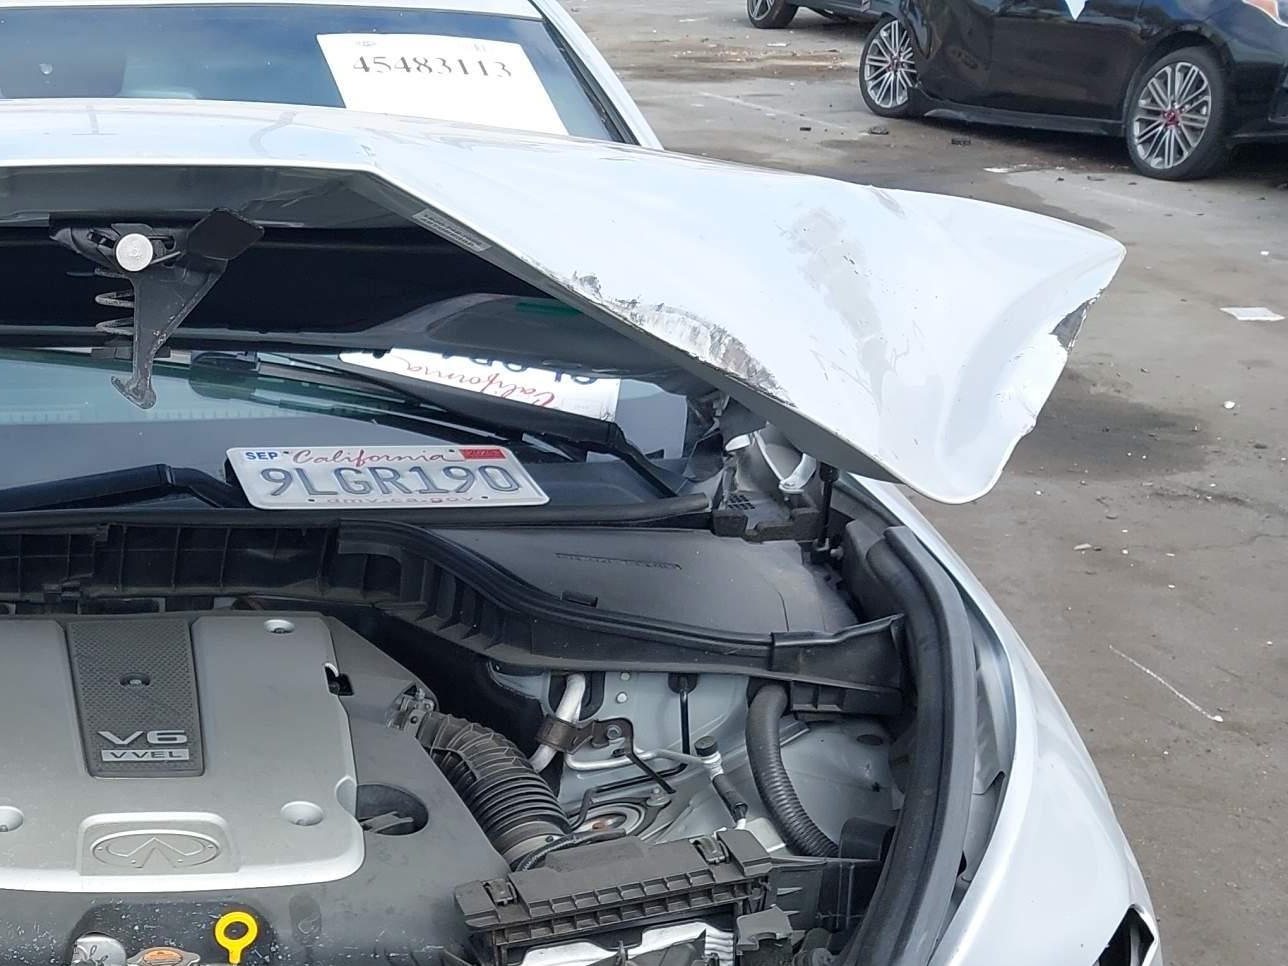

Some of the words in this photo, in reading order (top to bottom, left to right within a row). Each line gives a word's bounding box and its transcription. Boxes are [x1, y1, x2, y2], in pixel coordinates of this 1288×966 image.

[353, 56, 512, 77] 45483113
[245, 451, 279, 461] SEP
[290, 449, 465, 467] California
[261, 465, 521, 497] 9LGR190
[97, 730, 188, 745] V6
